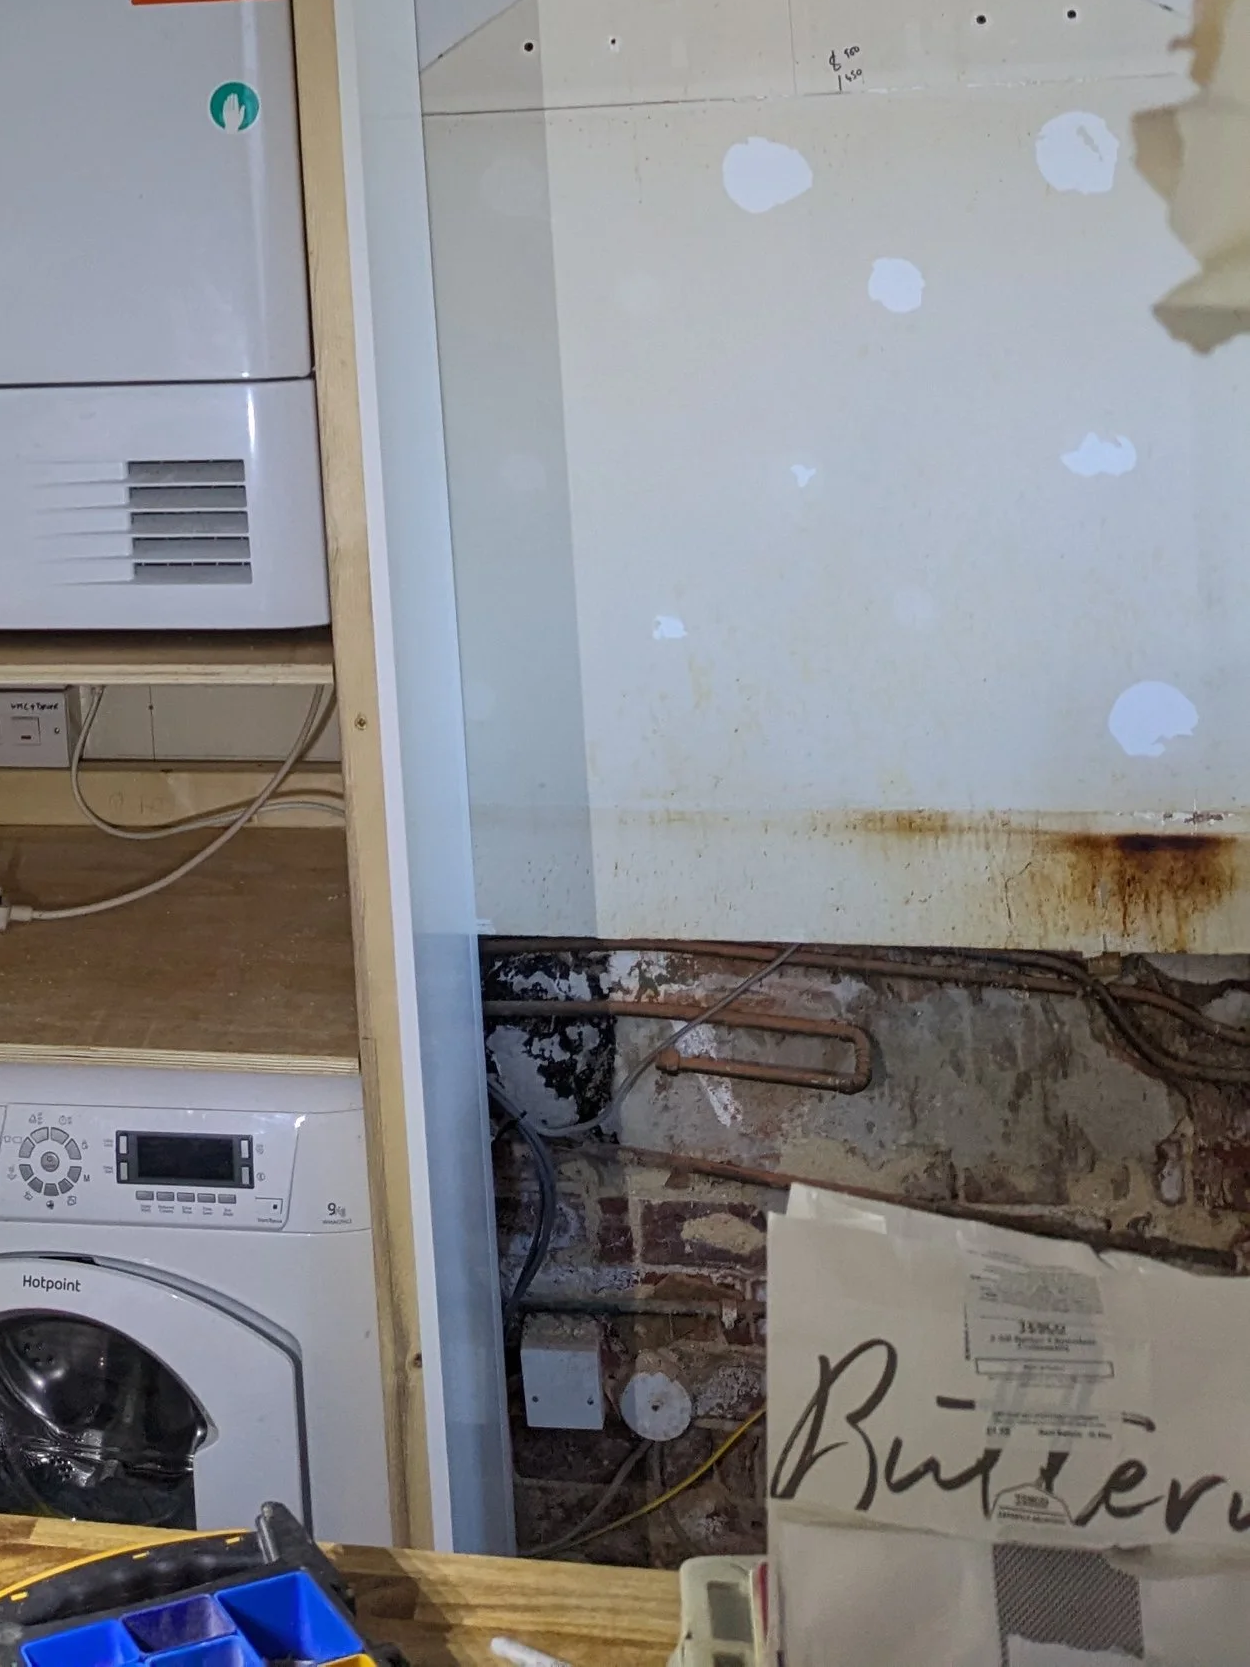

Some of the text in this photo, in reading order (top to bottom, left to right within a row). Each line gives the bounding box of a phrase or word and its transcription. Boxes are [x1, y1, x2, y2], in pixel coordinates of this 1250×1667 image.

[845, 68, 862, 82] 450
[83, 1174, 90, 1182] M
[22, 1274, 82, 1293] Hotpoint
